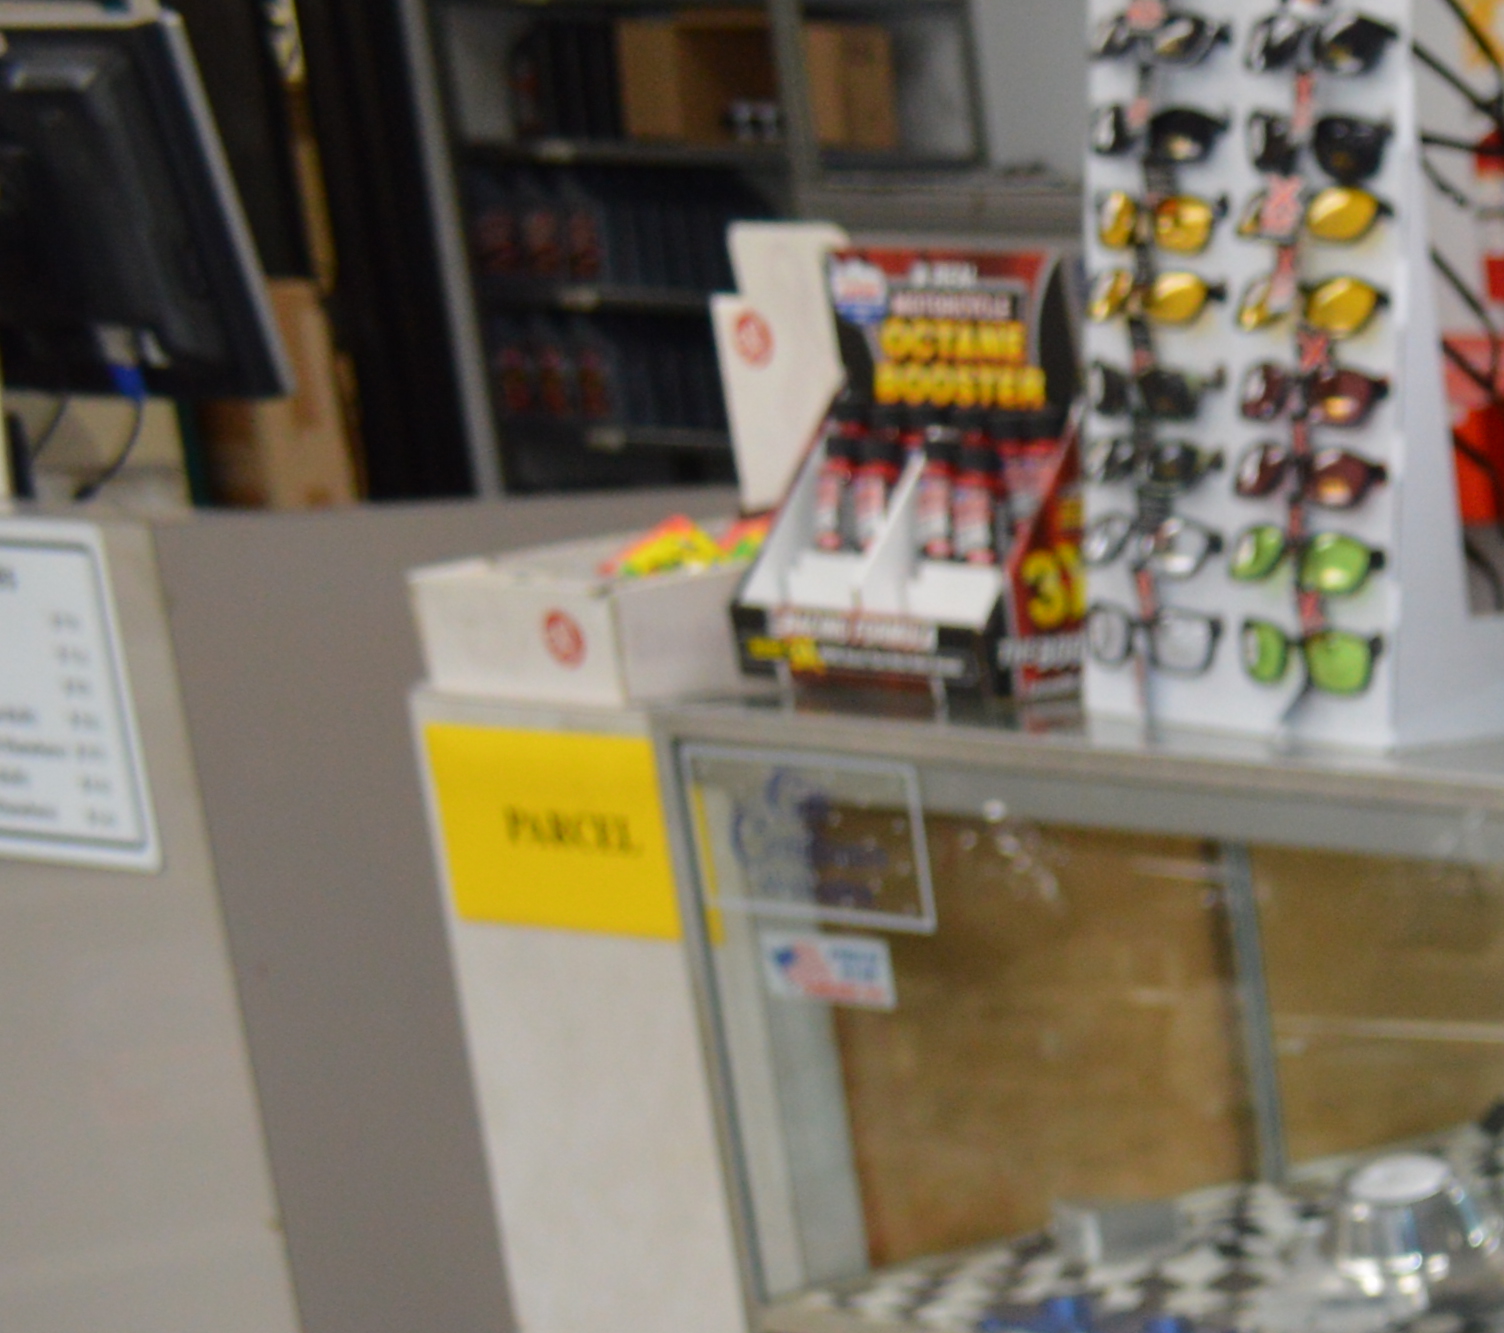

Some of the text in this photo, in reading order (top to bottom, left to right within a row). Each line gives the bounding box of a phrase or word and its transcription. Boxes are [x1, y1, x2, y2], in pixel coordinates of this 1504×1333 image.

[880, 317, 1028, 361] OCTANE
[873, 360, 1046, 411] BOOSTER
[502, 806, 645, 855] PARCEL
